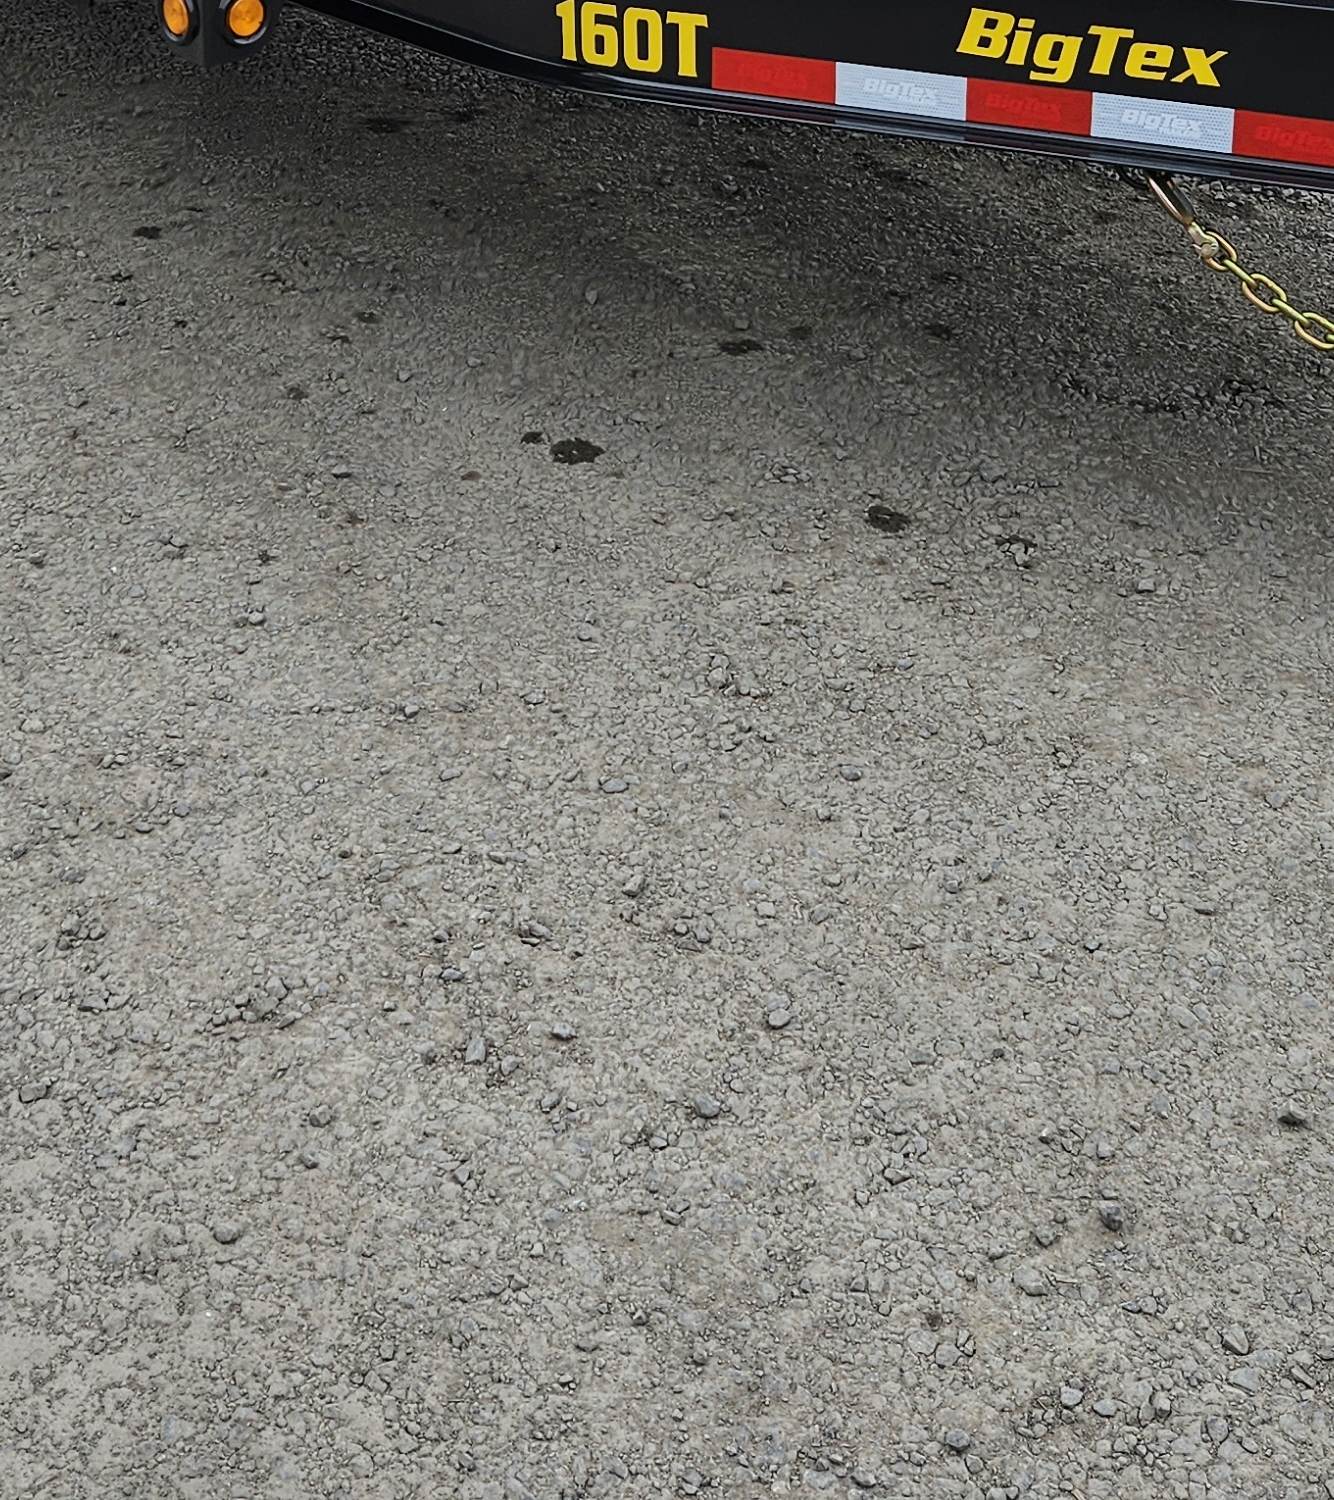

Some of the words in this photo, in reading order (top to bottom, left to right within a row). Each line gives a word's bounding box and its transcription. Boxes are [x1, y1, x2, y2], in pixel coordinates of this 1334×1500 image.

[957, 8, 1229, 88] BigTex
[863, 78, 939, 100] BigTex
[1121, 108, 1203, 131] BigTex
